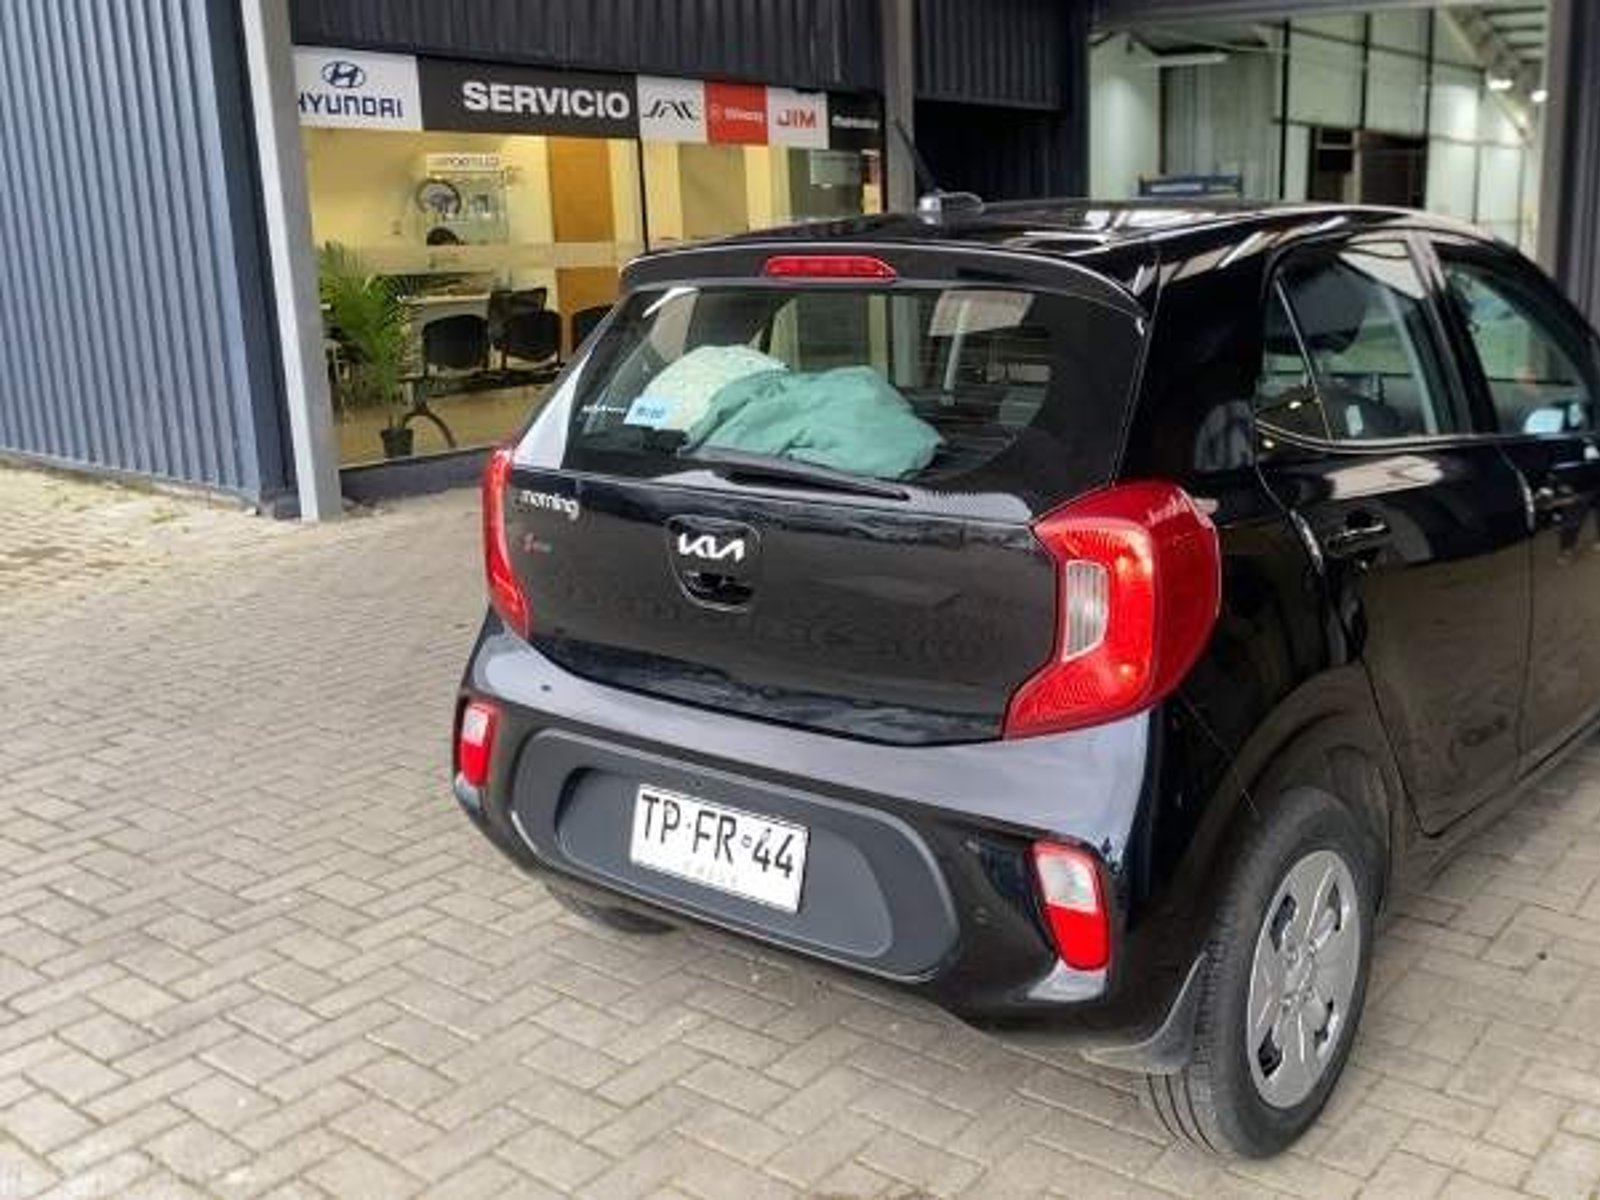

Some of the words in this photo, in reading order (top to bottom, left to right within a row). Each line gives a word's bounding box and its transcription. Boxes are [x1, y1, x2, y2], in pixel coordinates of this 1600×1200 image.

[463, 81, 630, 119] SERVICIO
[776, 108, 818, 129] JIM
[678, 532, 745, 563] KIA
